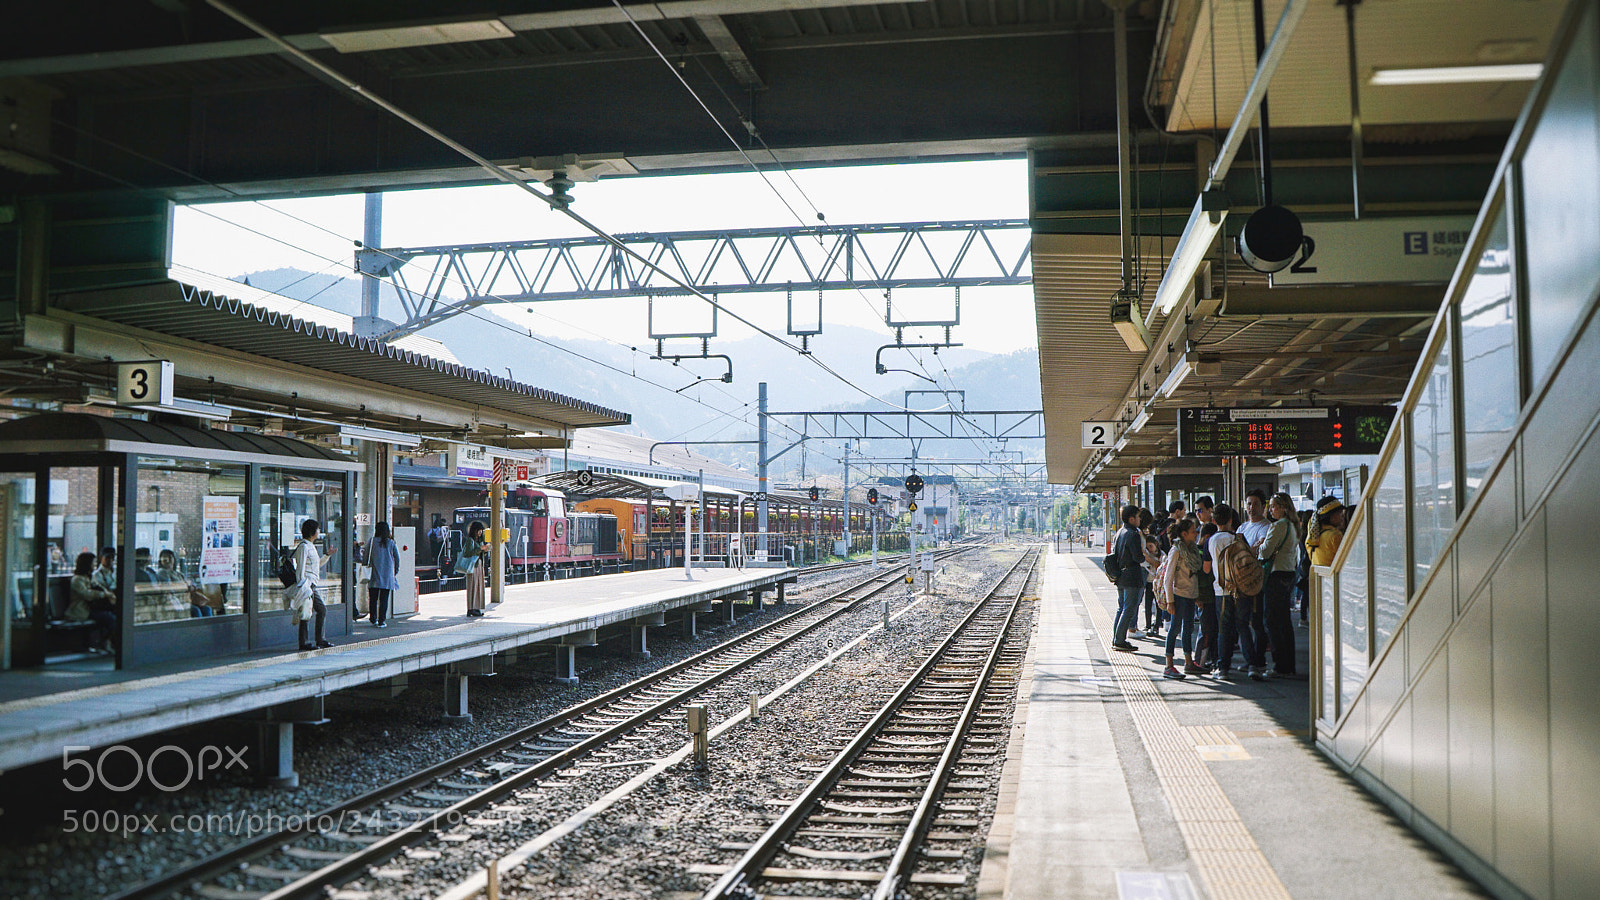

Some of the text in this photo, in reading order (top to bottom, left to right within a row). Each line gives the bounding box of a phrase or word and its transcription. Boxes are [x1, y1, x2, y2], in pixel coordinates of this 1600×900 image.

[1410, 234, 1424, 252] E
[1290, 235, 1317, 273] 2
[130, 368, 149, 399] 3
[1187, 410, 1194, 419] 2
[1194, 424, 1211, 432] Local
[1248, 424, 1273, 432] 16:02
[1092, 426, 1105, 445] 2
[1194, 433, 1211, 441] Local
[1248, 433, 1273, 441] 16:17
[1194, 442, 1211, 450] Local
[1248, 442, 1273, 450] 16:32
[582, 474, 588, 482] 6
[360, 514, 368, 522] 12
[827, 639, 834, 648] 6
